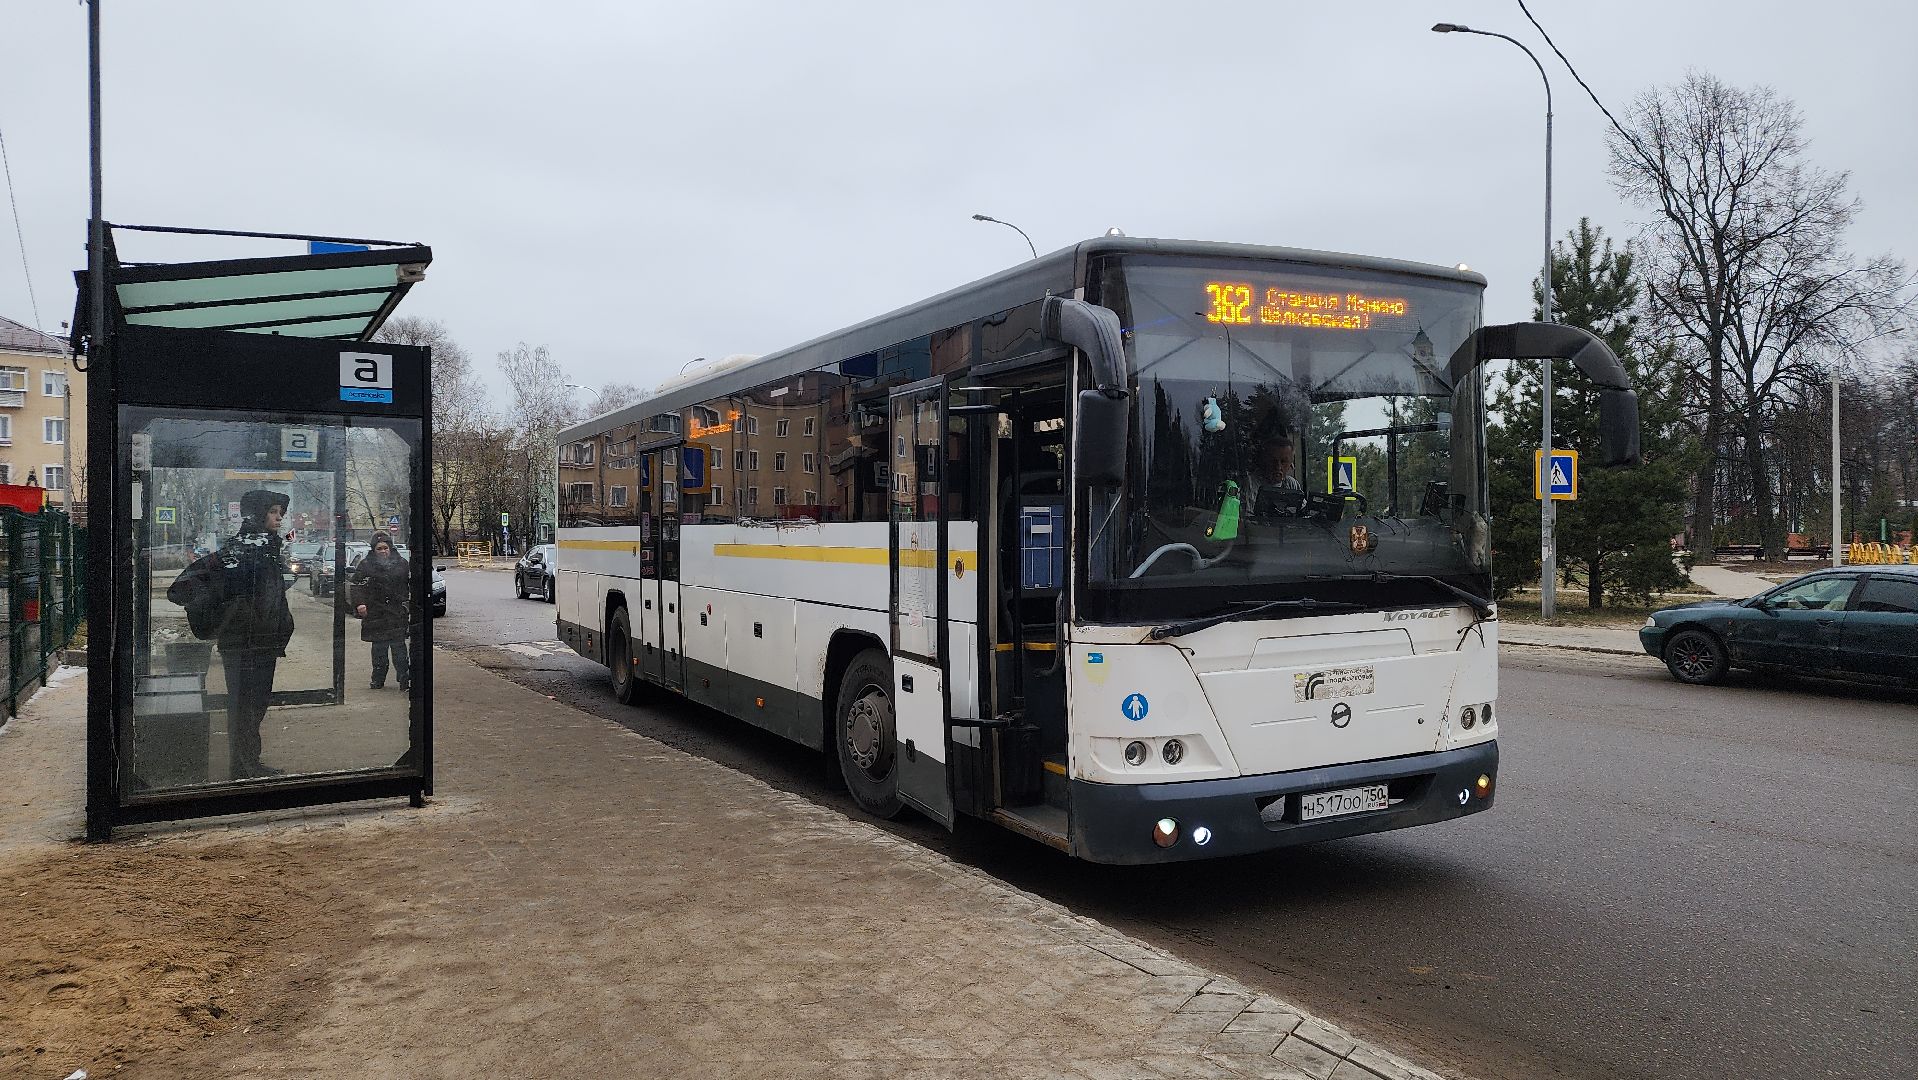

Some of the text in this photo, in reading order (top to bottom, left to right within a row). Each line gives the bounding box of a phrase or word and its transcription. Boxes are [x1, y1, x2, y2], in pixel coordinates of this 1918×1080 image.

[1206, 283, 1251, 323] 362
[1266, 288, 1405, 315] Станция Монино
[1363, 787, 1384, 803] 750
